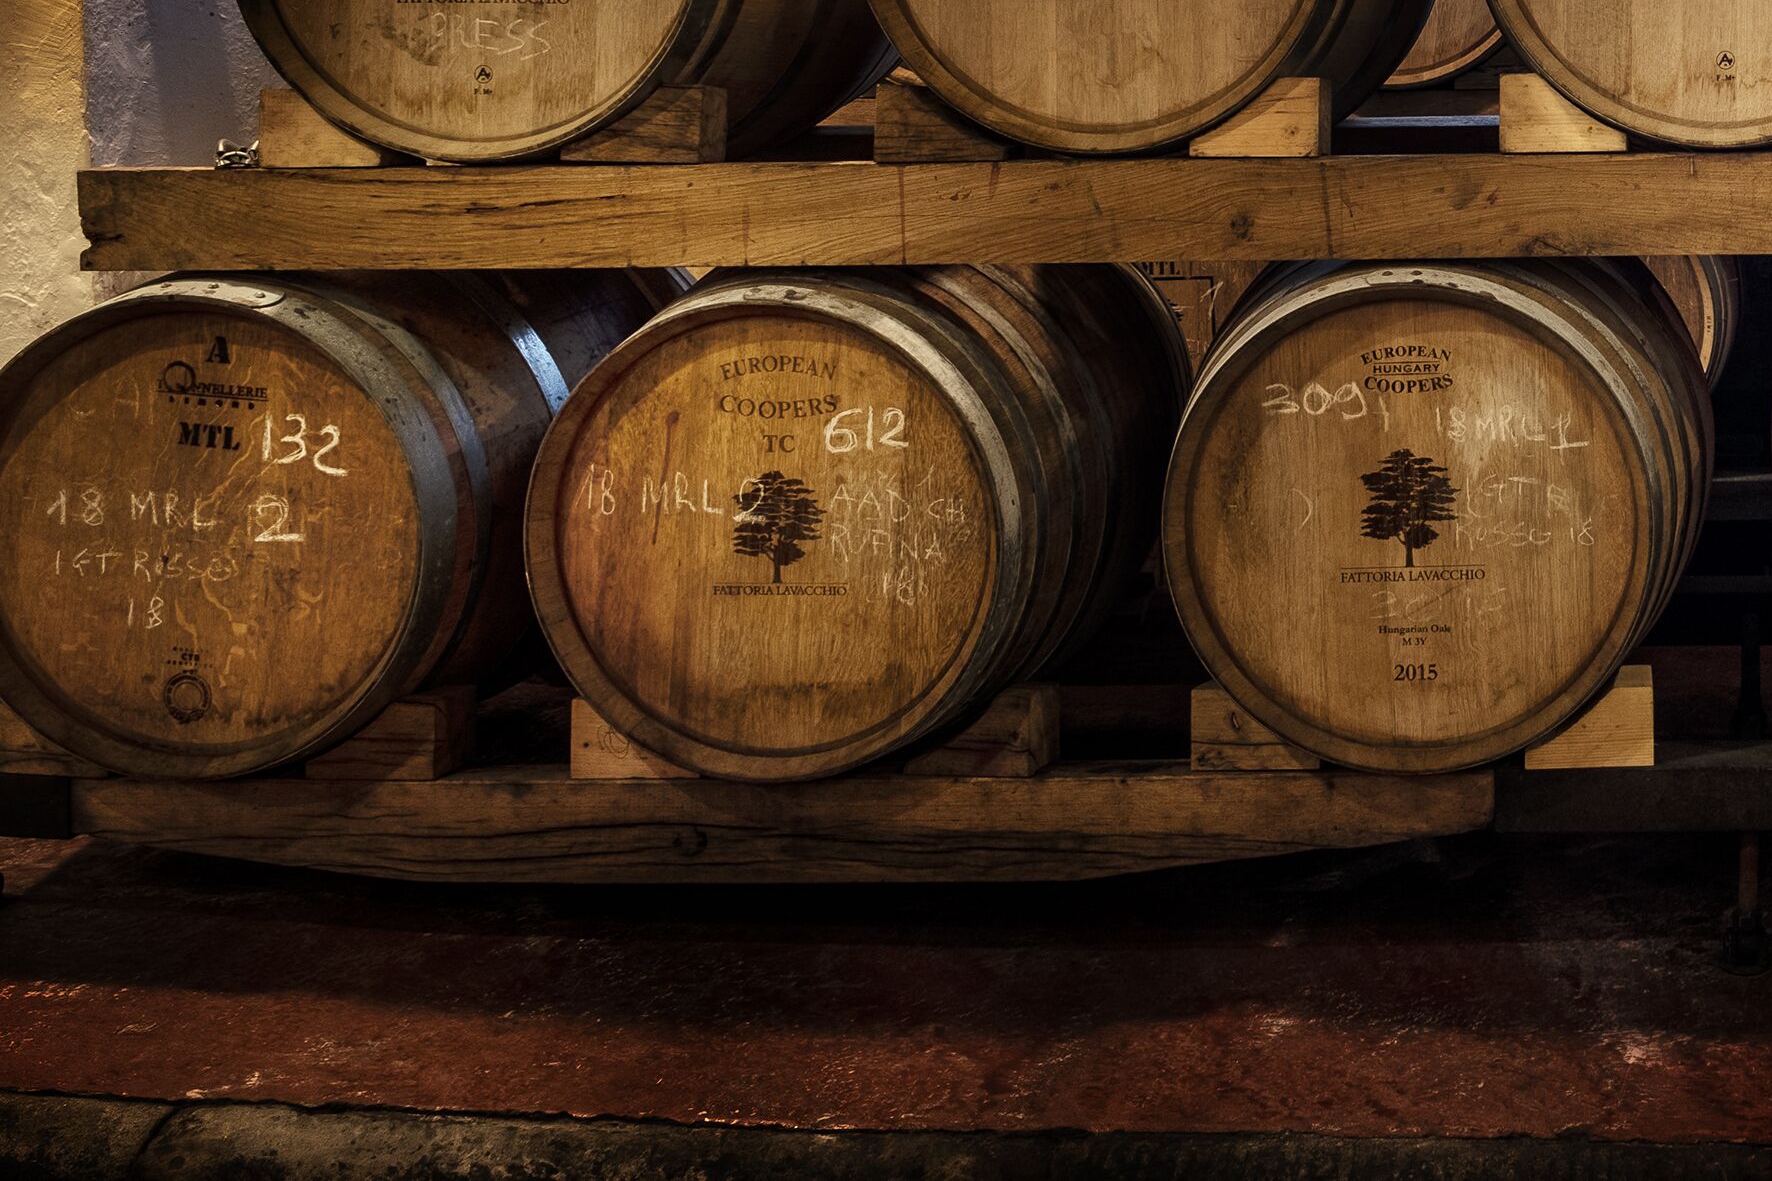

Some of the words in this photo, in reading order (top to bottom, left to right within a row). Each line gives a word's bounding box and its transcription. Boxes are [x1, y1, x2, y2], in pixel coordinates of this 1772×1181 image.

[206, 336, 230, 364] A
[1360, 345, 1452, 367] EUROPEAN
[720, 354, 838, 381] EUROPEAN
[1372, 363, 1440, 374] HUNGARY
[1364, 374, 1454, 394] COOPERS
[720, 394, 840, 419] COOPERS
[1262, 381, 1368, 421] 309
[178, 422, 241, 451] MTL
[824, 406, 909, 454] 612
[262, 410, 350, 477] 132
[762, 434, 796, 454] TC
[641, 471, 724, 517] MRL
[1570, 516, 1595, 545] 18
[1341, 571, 1406, 583] FATTORIA
[1409, 569, 1486, 581] LAVACCHIO
[713, 584, 774, 596] FATTORIA
[776, 584, 848, 596] LAVACCHIO
[127, 594, 164, 629] 18
[1379, 625, 1428, 635] Hungarian
[1431, 625, 1451, 633] Oak
[1394, 664, 1438, 681] 2015
